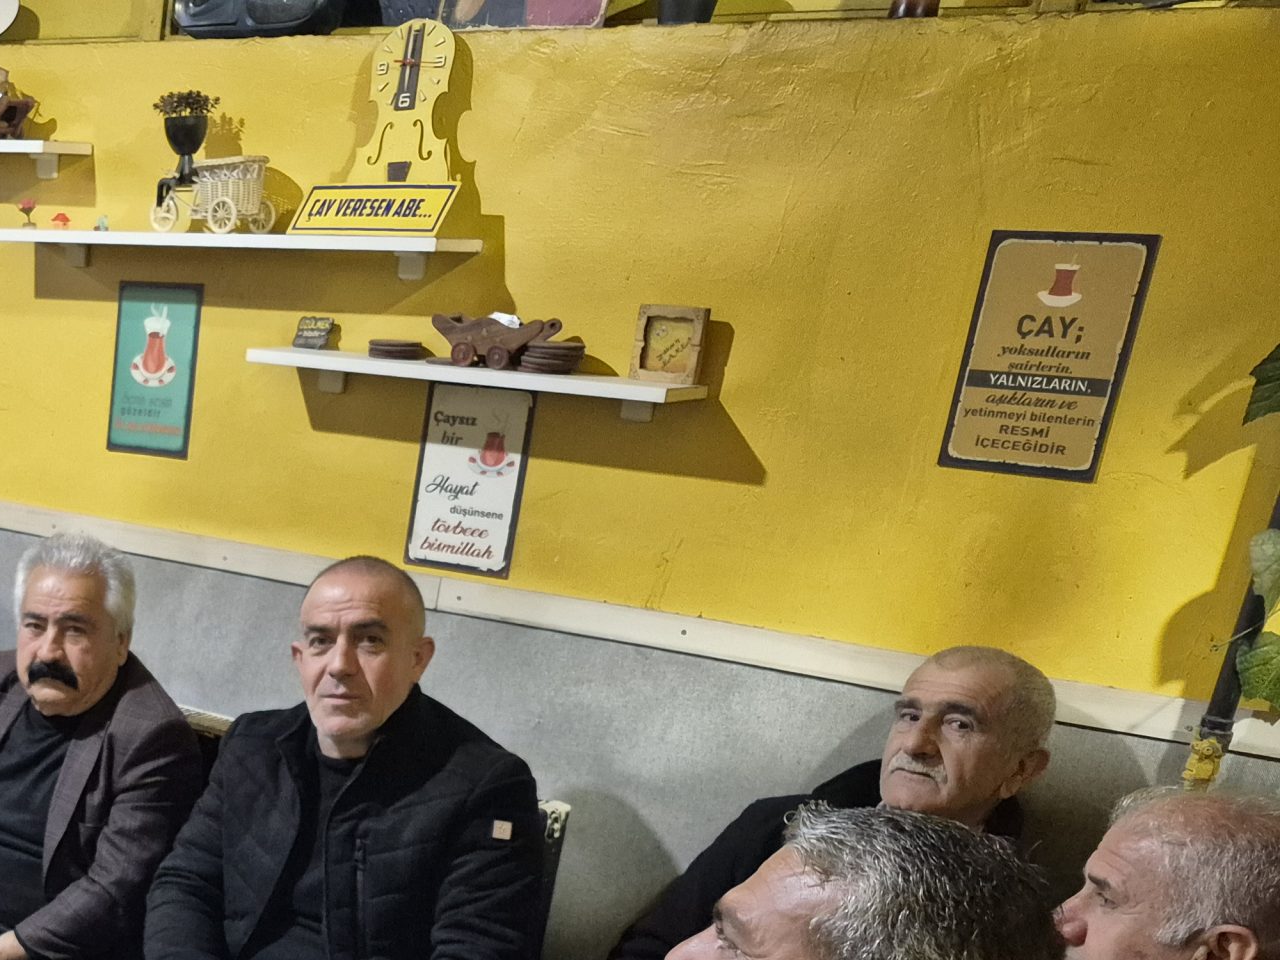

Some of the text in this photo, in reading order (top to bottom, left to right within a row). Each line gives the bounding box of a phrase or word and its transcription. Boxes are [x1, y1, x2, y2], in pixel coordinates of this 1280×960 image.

[398, 93, 411, 107] 6
[306, 199, 432, 222] ÇAY VERESEN ABE...
[1016, 314, 1085, 344] ÇAY;
[997, 344, 1091, 360] yoksulların
[989, 373, 1091, 393] YALNIZLARIN,
[985, 393, 1078, 410] aşıkların ve
[434, 411, 478, 427] Çaysız
[963, 407, 1095, 427] yetinmeyi bilenlerin
[441, 431, 463, 446] bir
[999, 425, 1050, 438] RESMİ
[975, 437, 1067, 455] İÇECEĞİDİR
[425, 474, 478, 501] Hayat
[450, 505, 504, 520] düşünsene
[420, 536, 495, 560] bismillah
